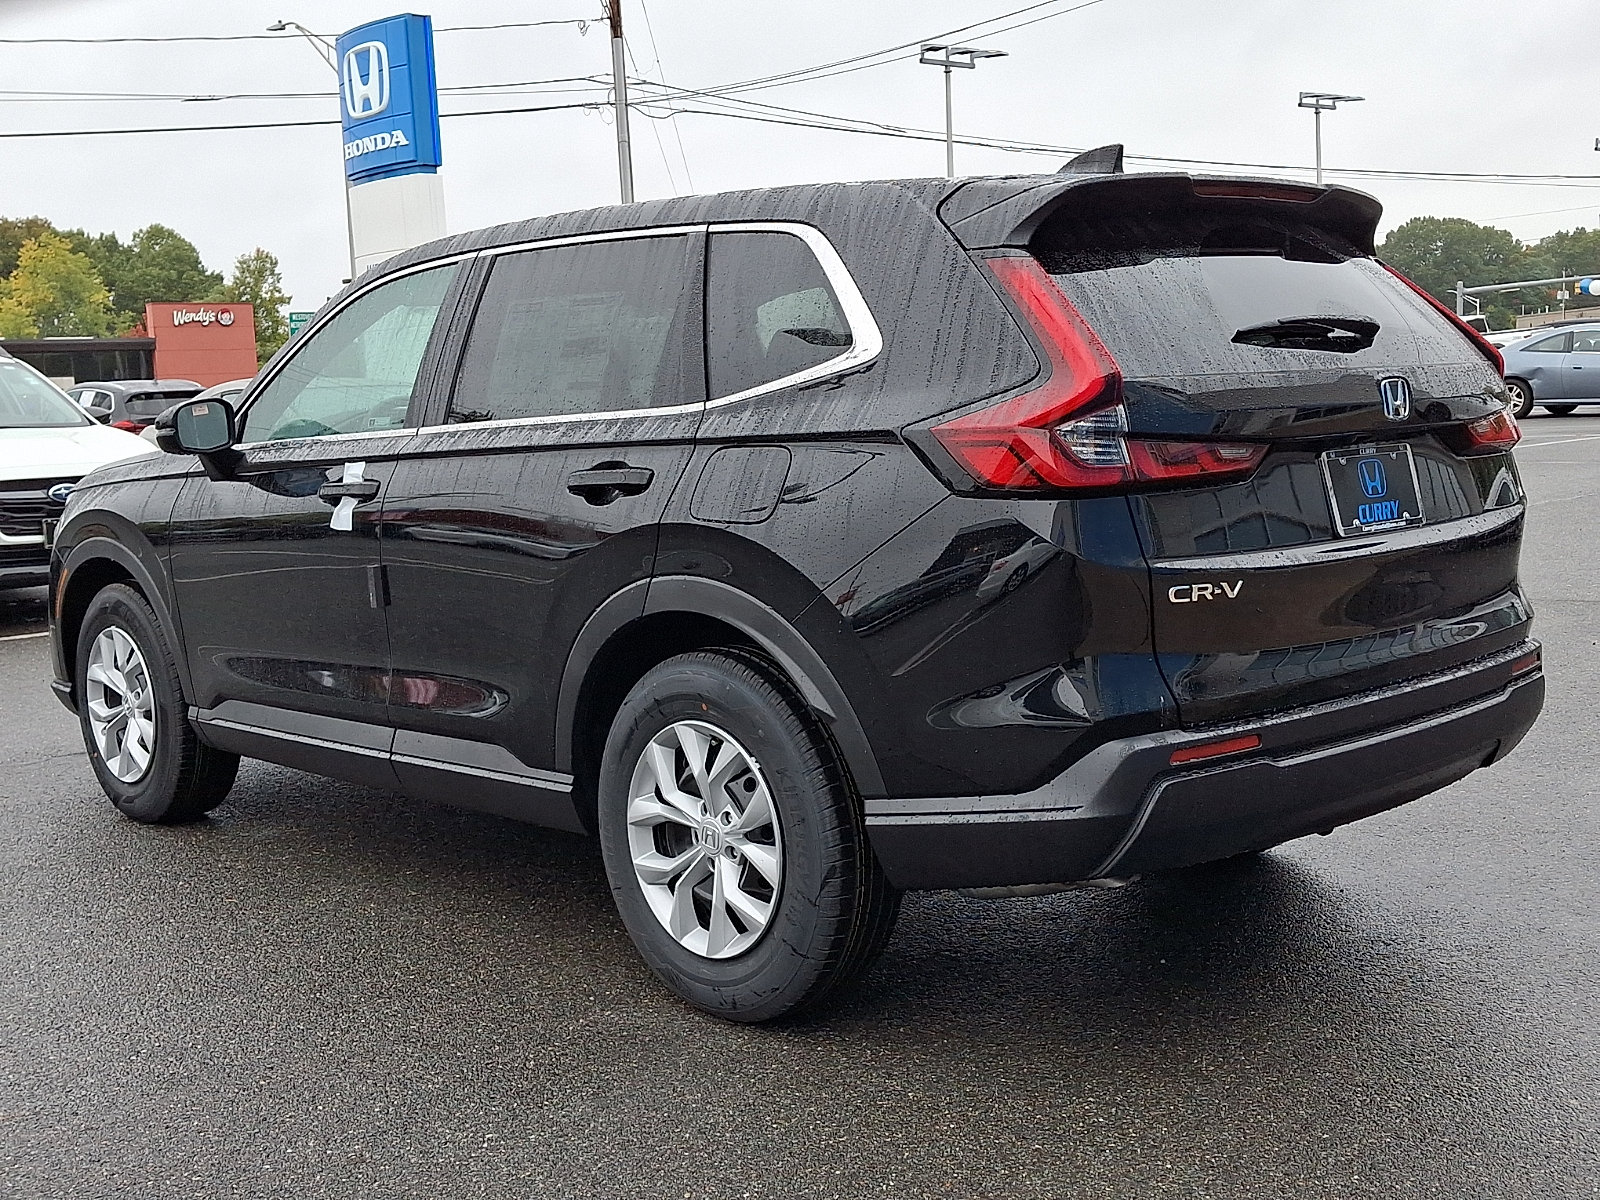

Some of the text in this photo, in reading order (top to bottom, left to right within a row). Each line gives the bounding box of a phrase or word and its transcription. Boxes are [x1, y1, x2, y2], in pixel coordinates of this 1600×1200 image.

[344, 129, 409, 160] HONDA
[173, 308, 215, 326] Wendy's
[1358, 500, 1399, 523] CURRY
[1168, 580, 1243, 603] CR-V
